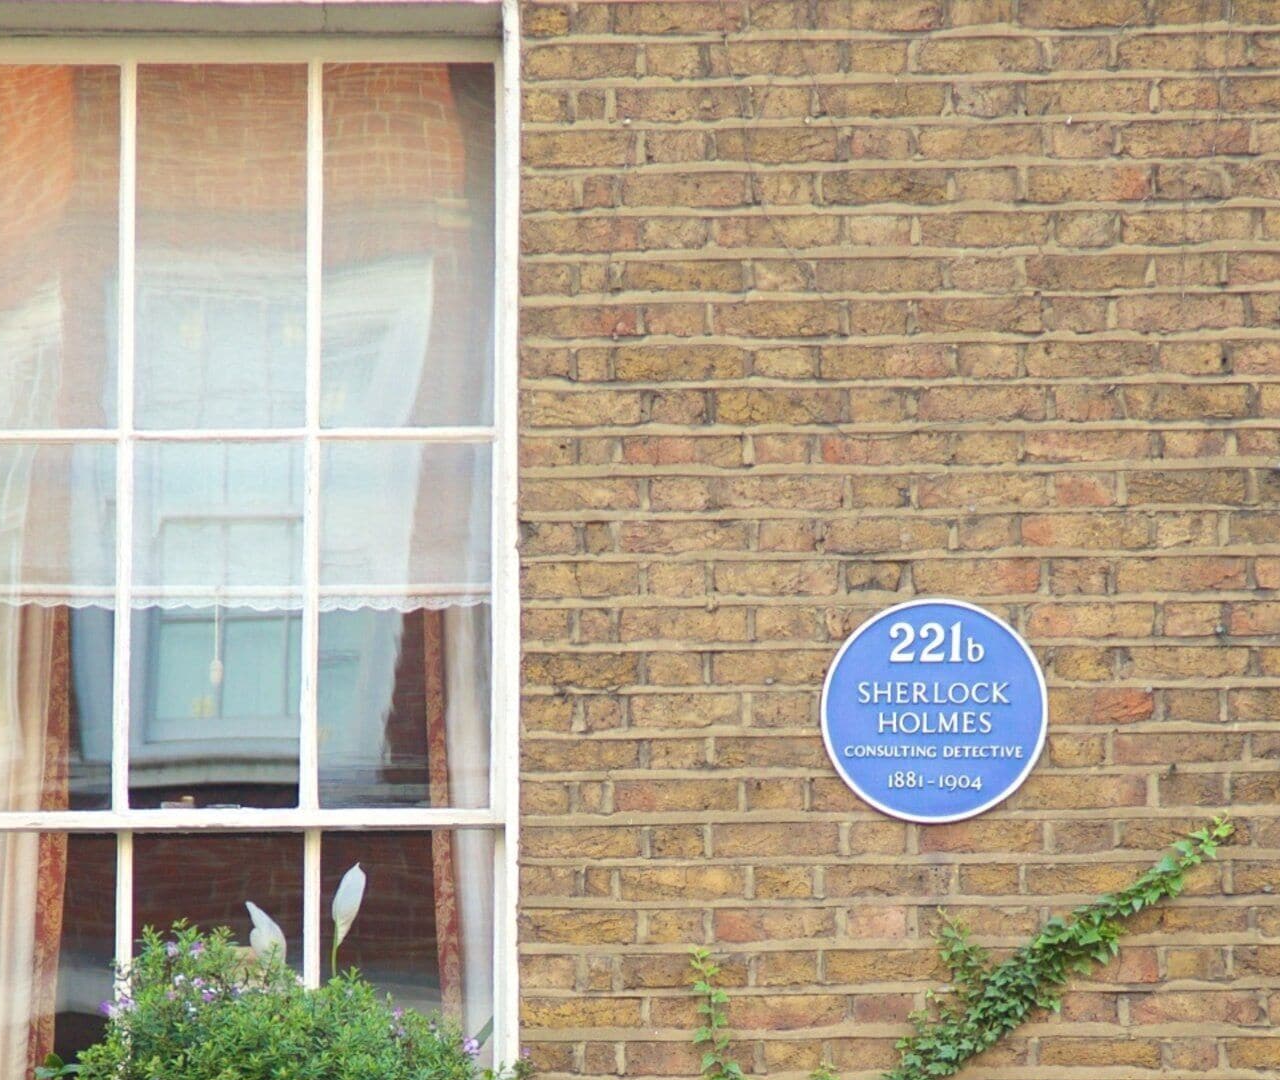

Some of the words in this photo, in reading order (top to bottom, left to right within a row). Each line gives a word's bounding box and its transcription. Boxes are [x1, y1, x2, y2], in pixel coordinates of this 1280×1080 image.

[889, 621, 985, 664] 221b
[858, 682, 1011, 704] SHERLOCK
[878, 712, 993, 734] HOLMES
[844, 745, 937, 759] CONSULTING
[943, 745, 1024, 759] DETECTIVE
